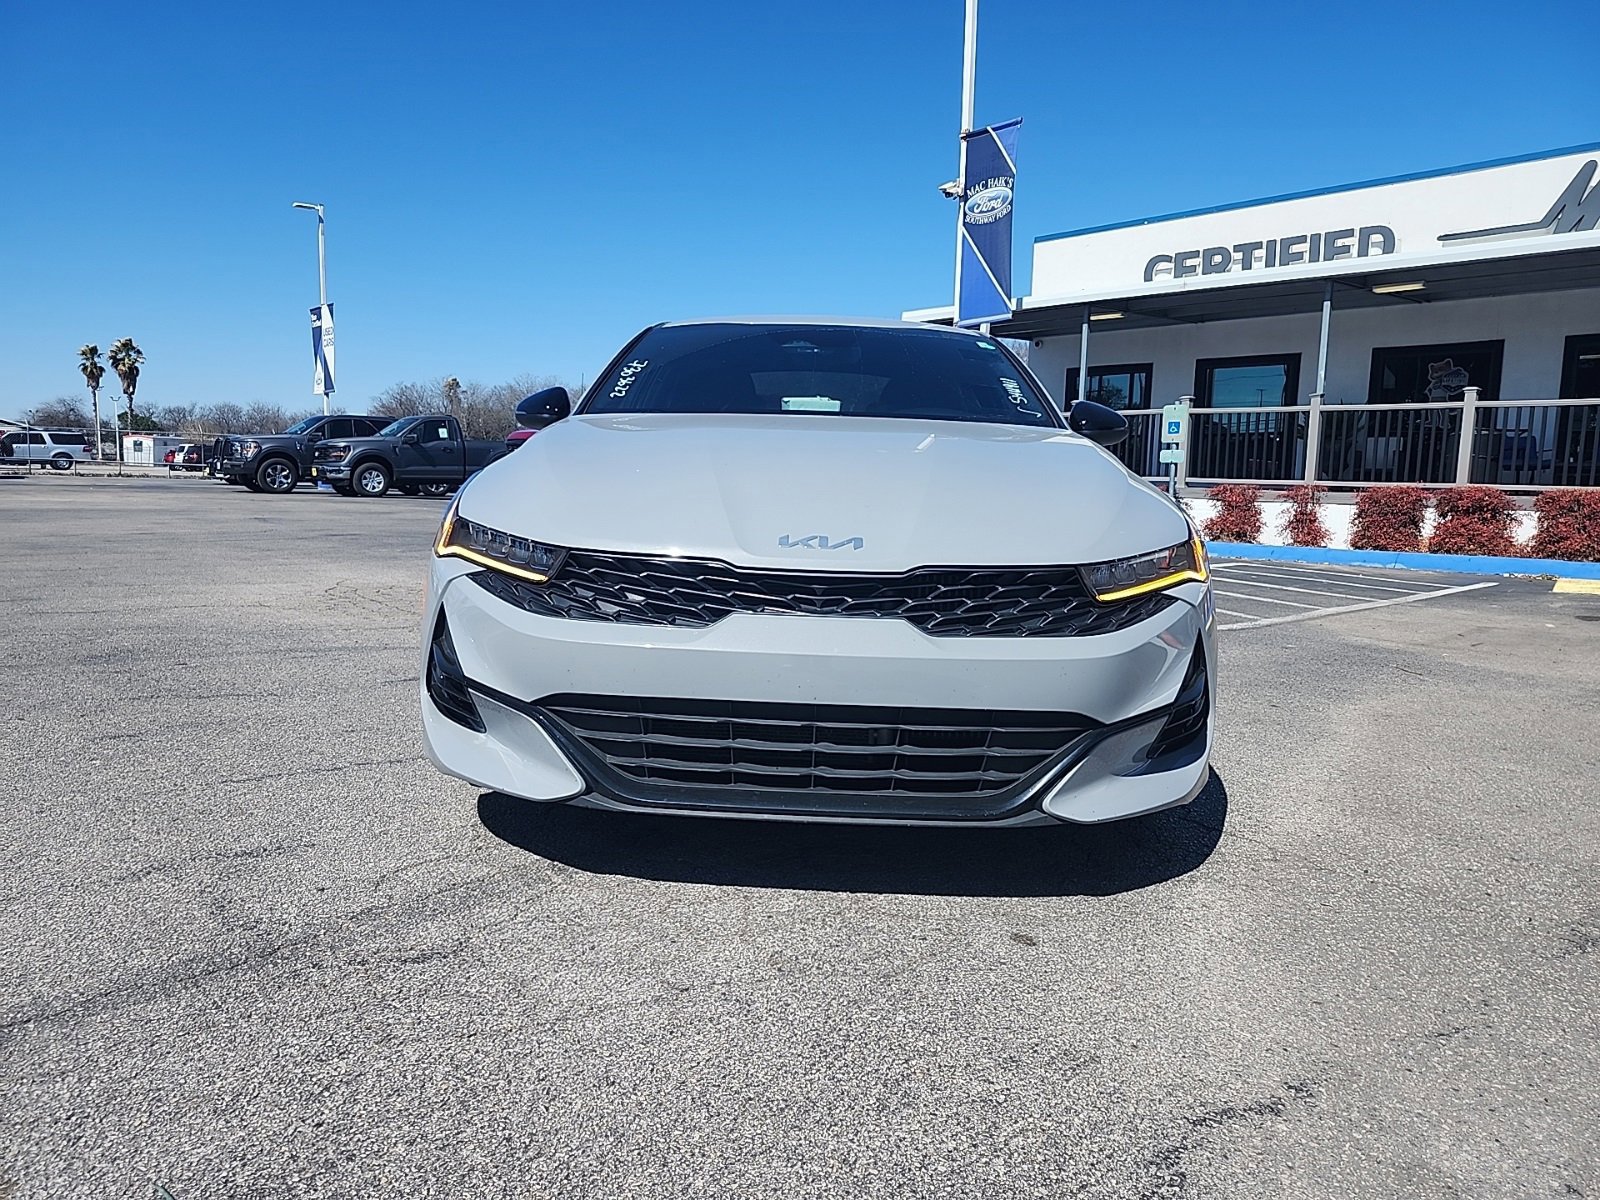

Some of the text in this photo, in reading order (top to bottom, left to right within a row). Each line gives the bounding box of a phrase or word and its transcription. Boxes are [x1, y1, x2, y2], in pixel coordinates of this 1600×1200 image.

[966, 177, 1013, 198] MAC HAIK'S
[973, 195, 1003, 213] Ford
[965, 205, 1011, 225] SOUTHWAY FORD
[778, 533, 864, 551] KIA
